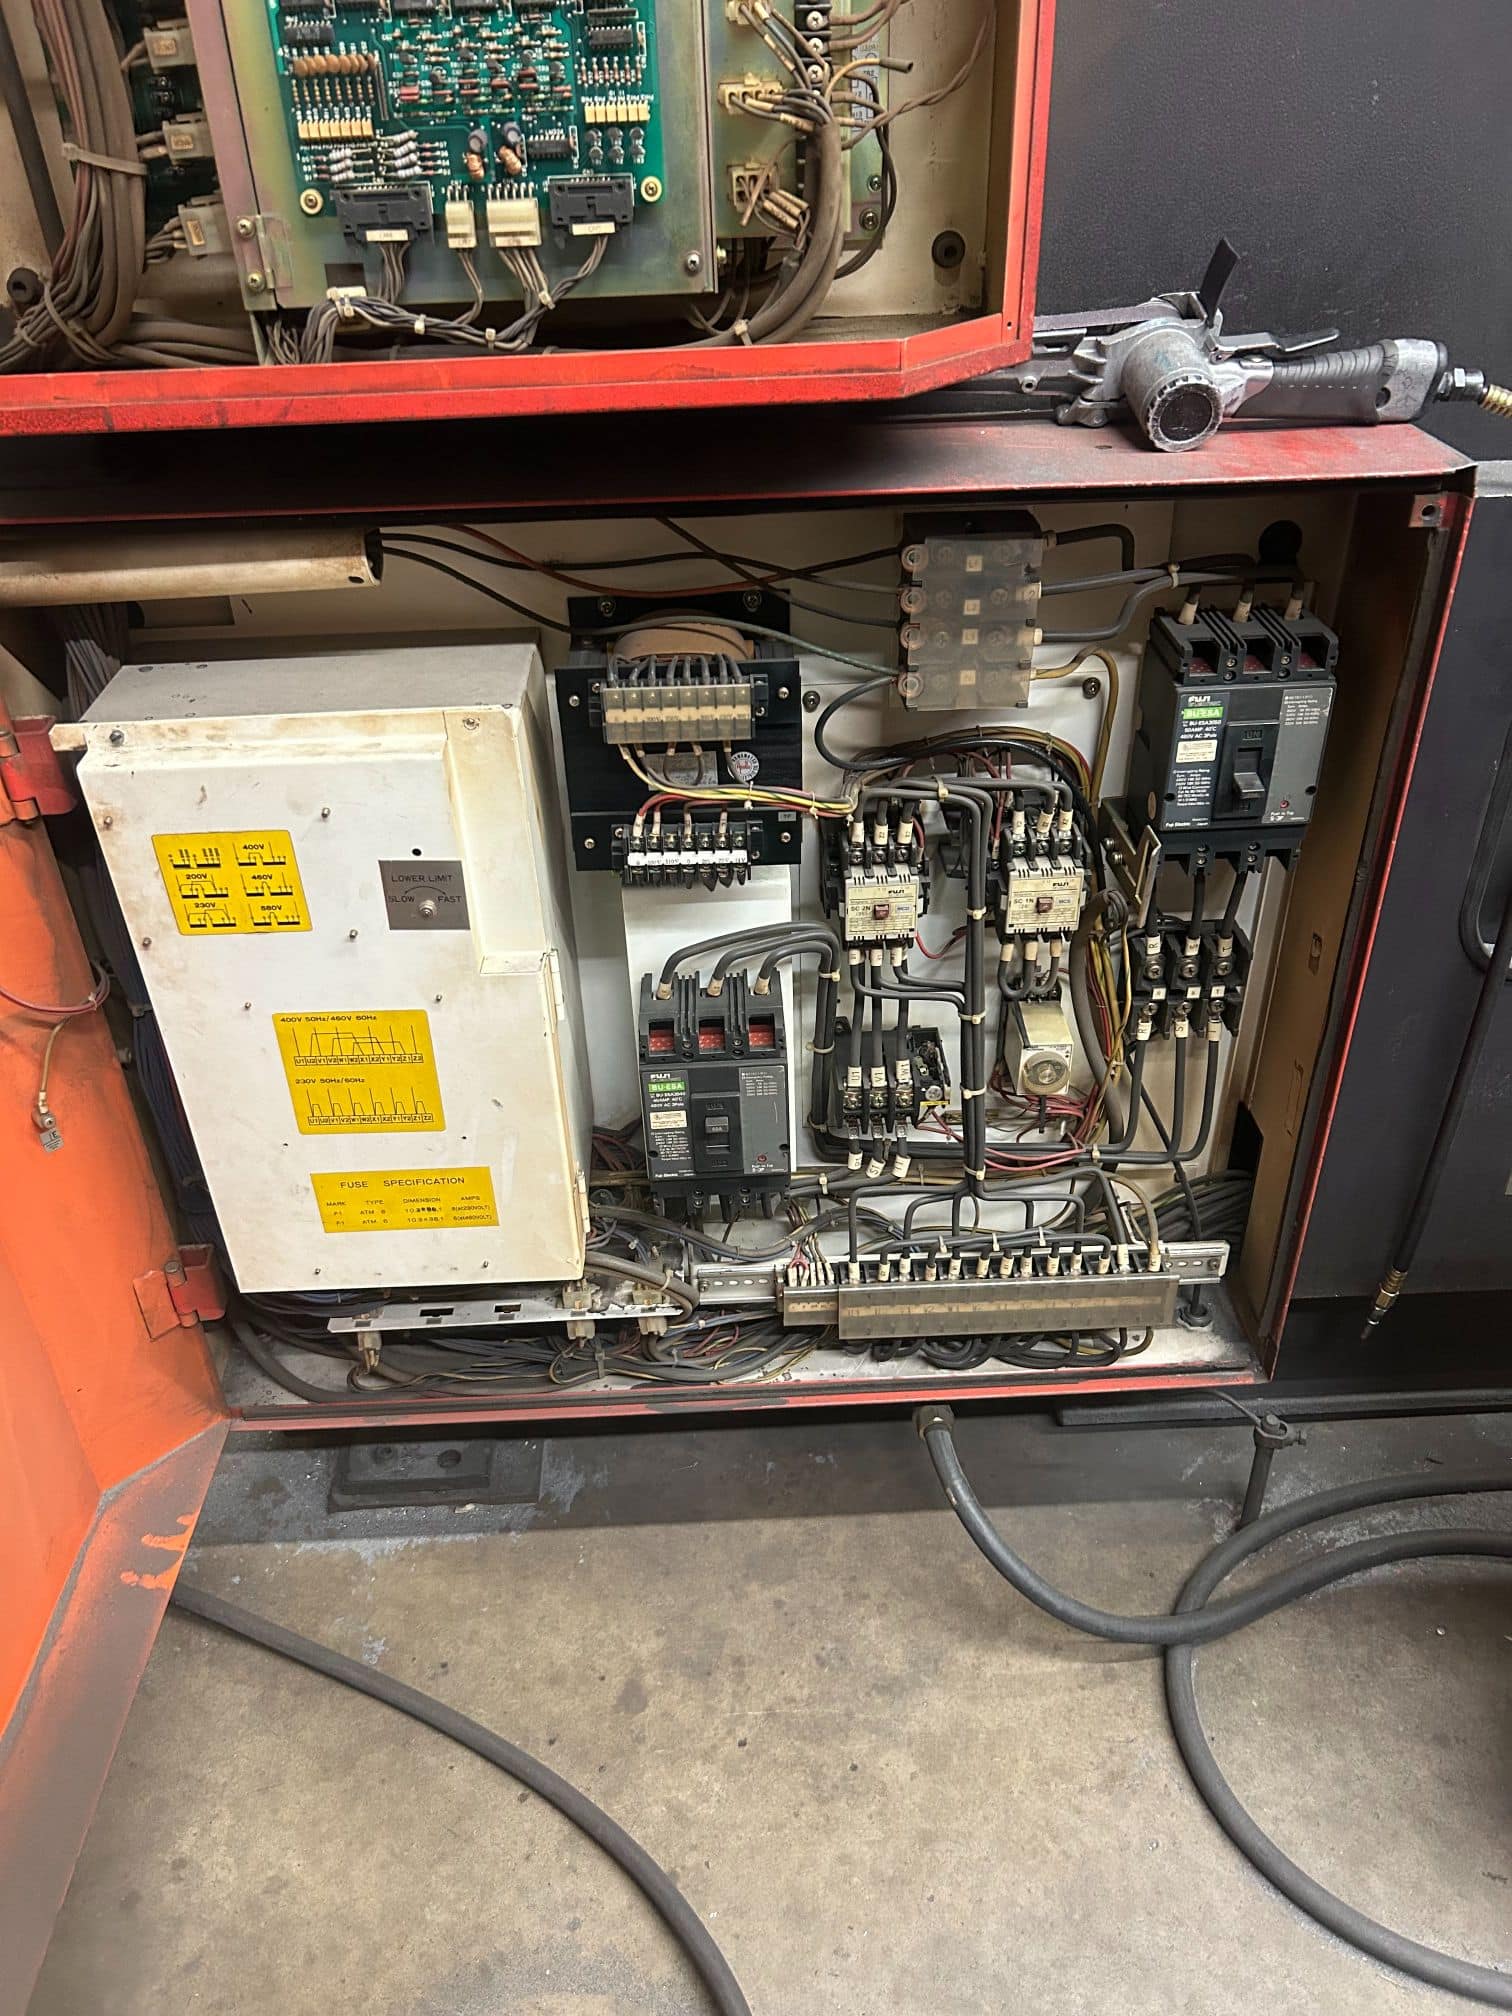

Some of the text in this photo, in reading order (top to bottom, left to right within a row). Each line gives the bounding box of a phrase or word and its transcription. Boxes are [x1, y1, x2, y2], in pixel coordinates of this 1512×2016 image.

[429, 874, 453, 882] LIMIT
[340, 1177, 465, 1189] FUSE SPECIFICATION
